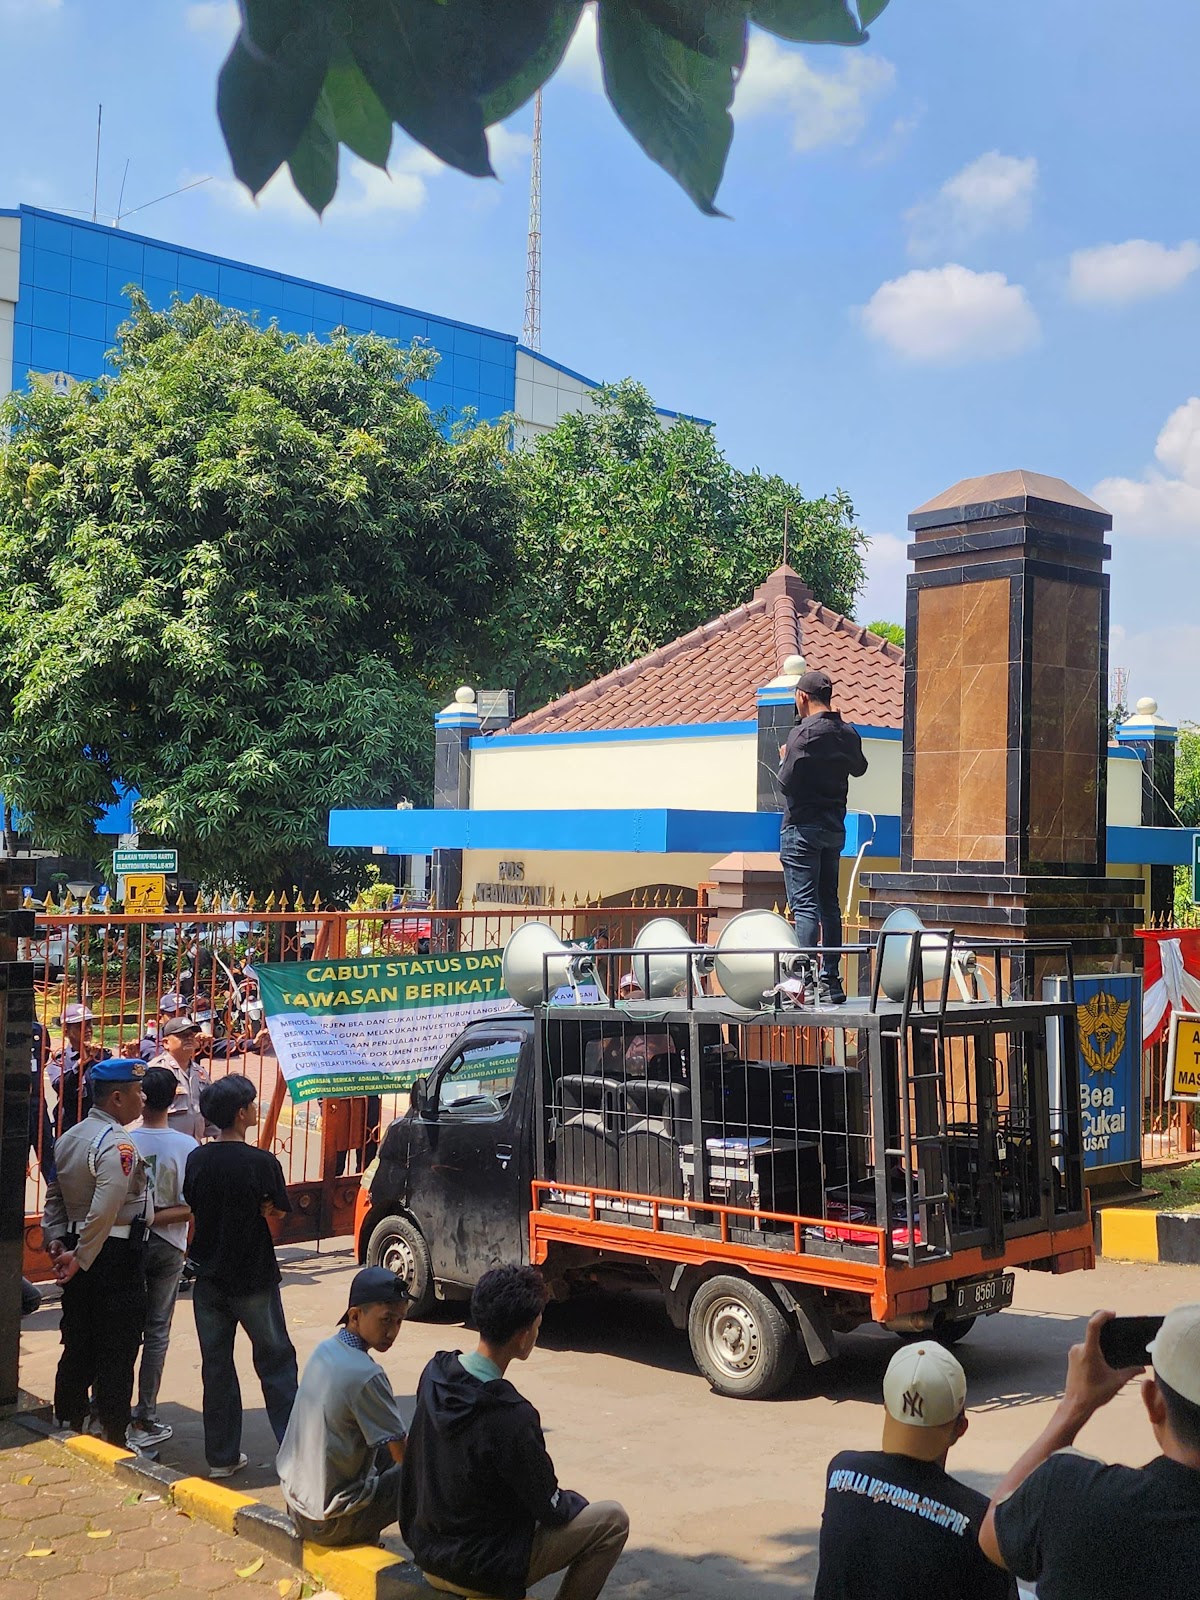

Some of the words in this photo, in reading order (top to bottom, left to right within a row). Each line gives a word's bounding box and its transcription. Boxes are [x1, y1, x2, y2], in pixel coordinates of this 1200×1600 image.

[498, 862, 525, 880] POS
[306, 964, 380, 982] CABUT
[386, 958, 462, 977] STATUS
[406, 978, 494, 1000] BERIKAT
[366, 1018, 386, 1026] DAN
[387, 1016, 414, 1024] CUKAI
[416, 1012, 444, 1020] UNTUK
[446, 1010, 471, 1018] TURUN
[554, 992, 593, 1000] KAWSAN
[284, 1030, 313, 1038] BERIKAT
[367, 1026, 418, 1036] MELAKUKAN
[372, 1037, 420, 1047] PENJUALAN
[422, 1034, 444, 1042] ATAU
[291, 1051, 321, 1059] BERIKAT
[370, 1048, 412, 1058] DOKUMEN
[378, 1057, 422, 1067] KAWASAN
[296, 1078, 330, 1088] KAWASAN
[1080, 1084, 1114, 1110] Bea
[1081, 1106, 1126, 1138] Cukai
[1082, 1136, 1110, 1152] USAT
[958, 1290, 964, 1306] D
[975, 1282, 996, 1302] 8560
[902, 1390, 924, 1418] NY
[854, 1472, 869, 1492] LA
[867, 1478, 920, 1514] VICTORIA
[918, 1496, 970, 1536] SIEMPRE
